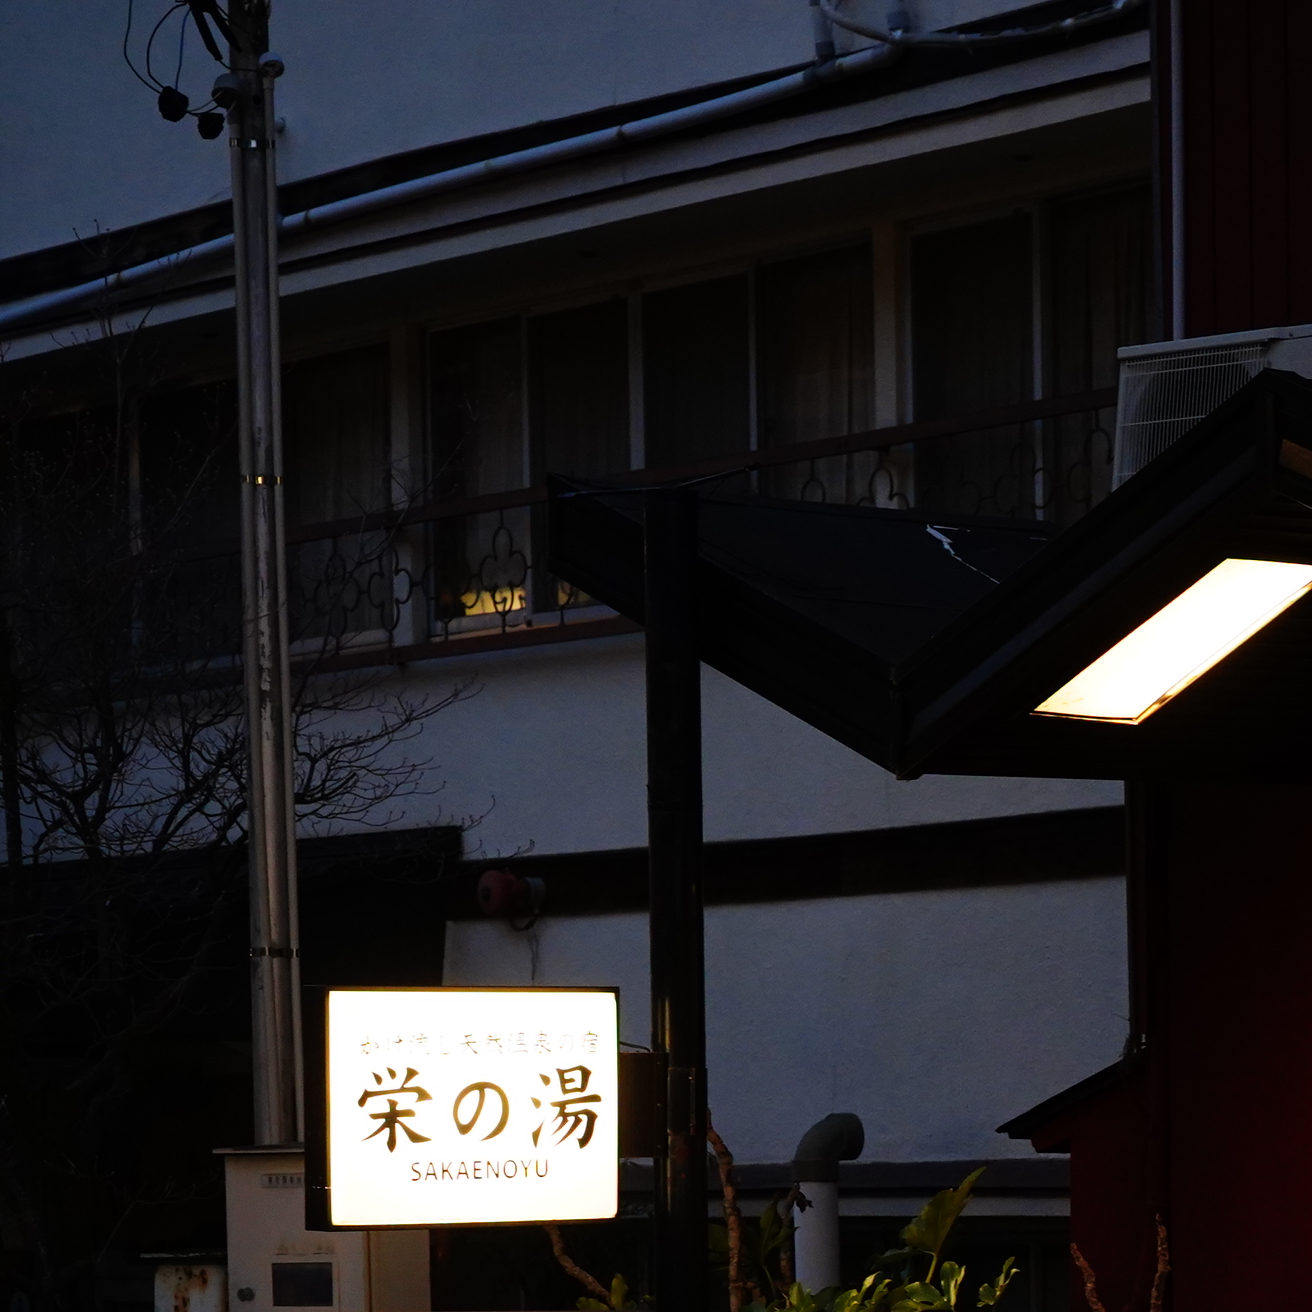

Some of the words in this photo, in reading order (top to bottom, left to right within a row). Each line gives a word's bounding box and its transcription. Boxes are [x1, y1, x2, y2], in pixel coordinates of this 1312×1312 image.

[357, 1064, 602, 1153] 栄の湯
[410, 1159, 549, 1182] SAKAENOYU
